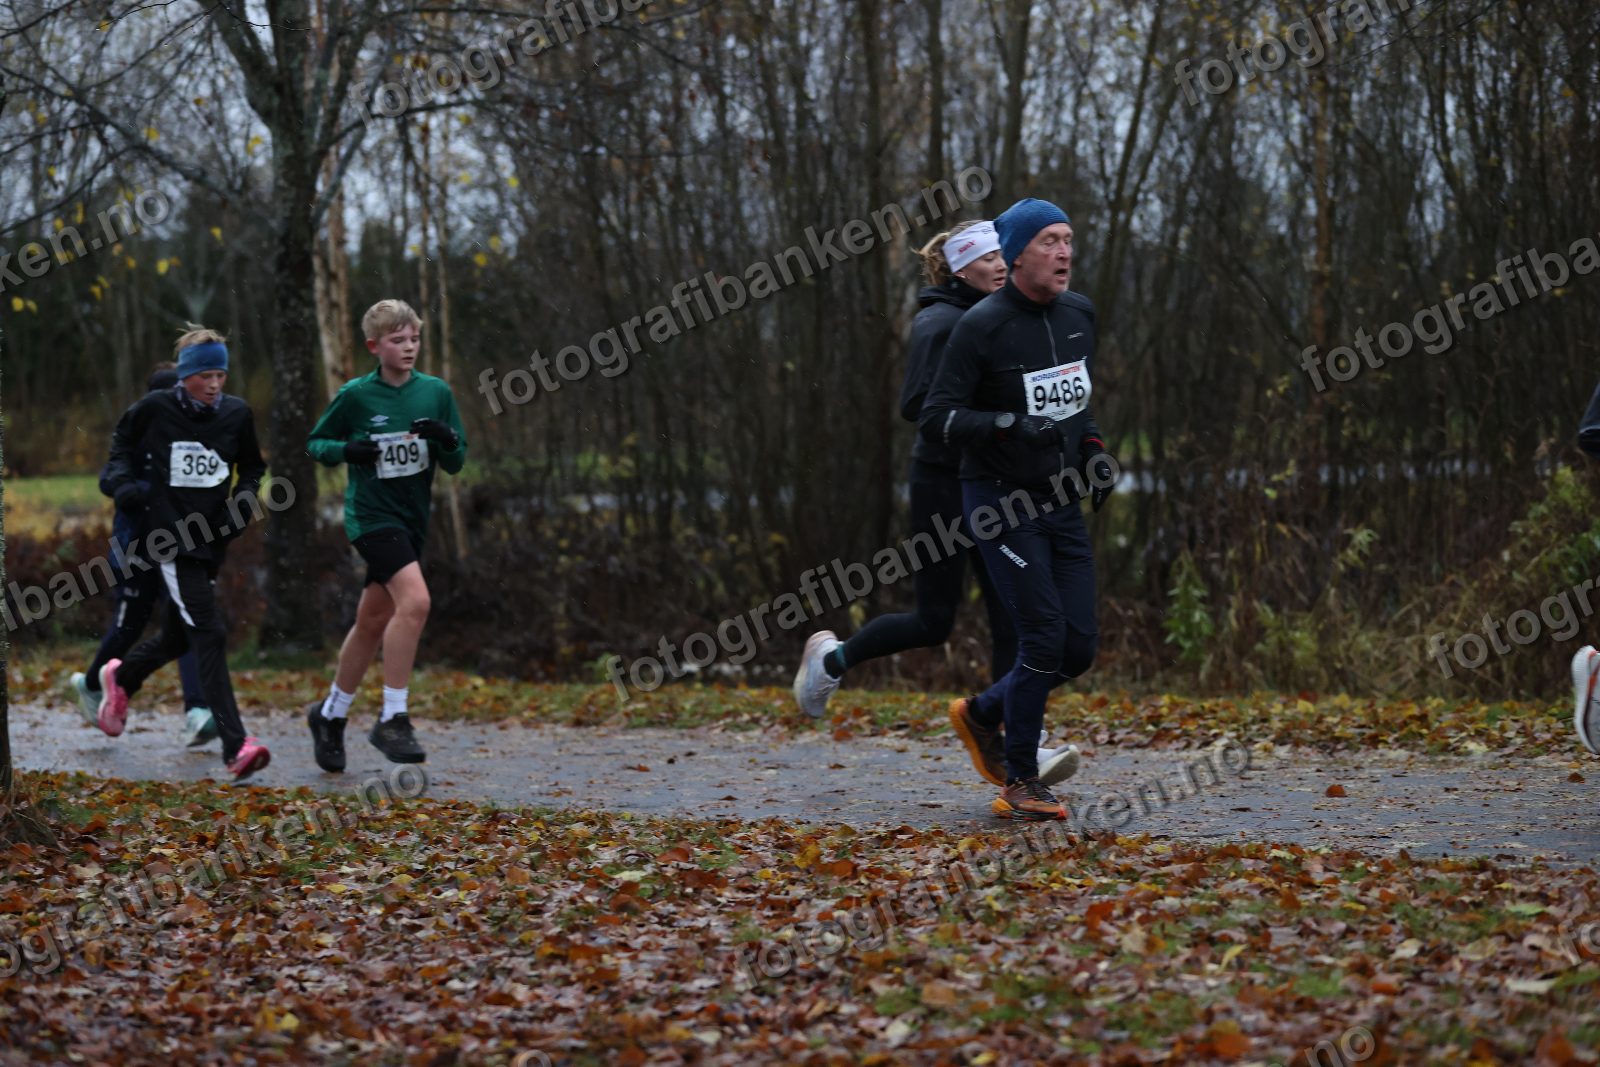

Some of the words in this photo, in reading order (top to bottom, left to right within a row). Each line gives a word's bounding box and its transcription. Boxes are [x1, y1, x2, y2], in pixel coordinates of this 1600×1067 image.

[1033, 376, 1085, 411] 9486
[182, 454, 219, 476] 369
[384, 442, 419, 466] 409
